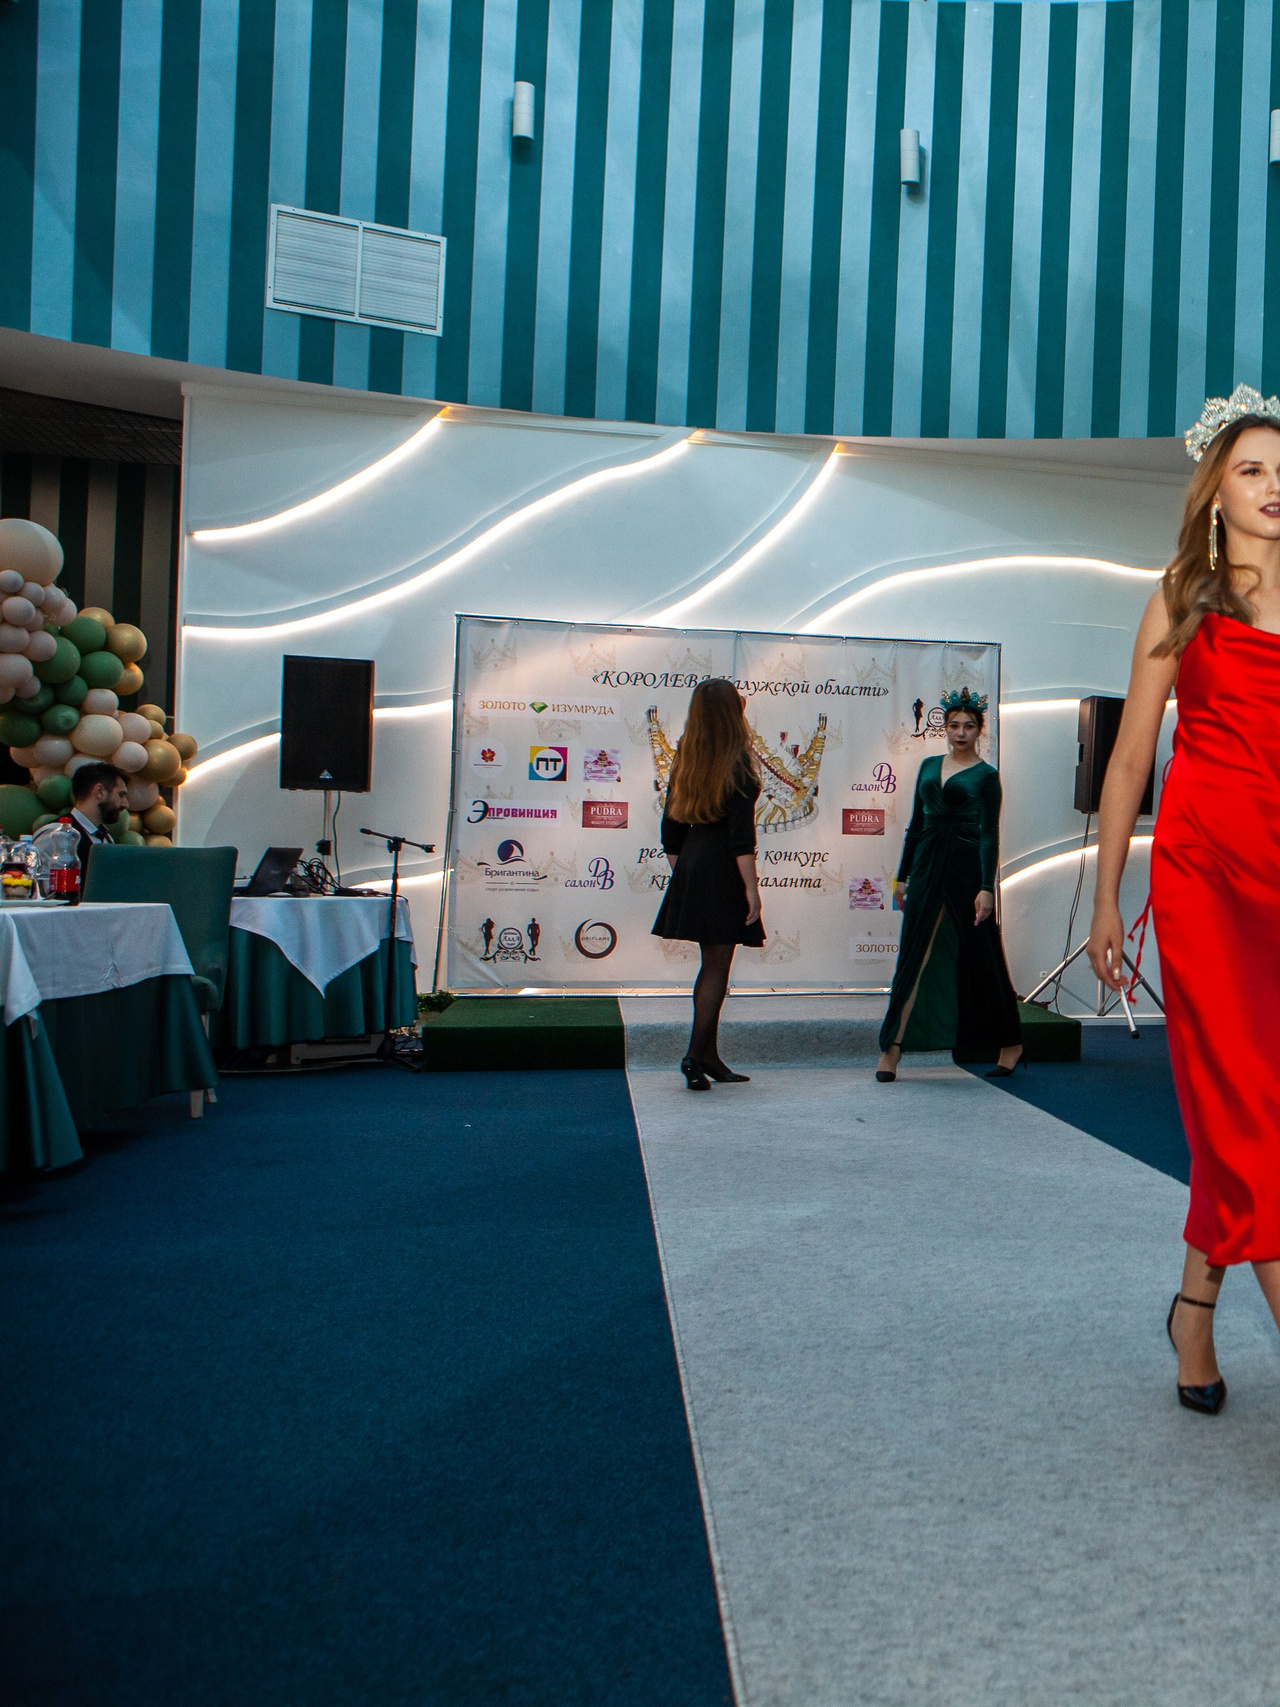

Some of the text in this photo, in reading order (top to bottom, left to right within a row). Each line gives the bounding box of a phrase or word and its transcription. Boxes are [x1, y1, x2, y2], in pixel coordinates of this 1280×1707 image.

[718, 675, 810, 697] алужской
[814, 678, 890, 698] области»
[478, 700, 615, 716] ЗОЛОТО ИЗУМРУДА
[536, 757, 562, 772] ПТ
[851, 783, 880, 792] салон
[590, 806, 623, 816] PUDRA
[849, 814, 880, 823] PUDRA
[764, 850, 830, 868] конкурс
[485, 867, 540, 878] Бригантина
[564, 878, 596, 888] салон
[855, 943, 899, 953] ЗОЛОТО
